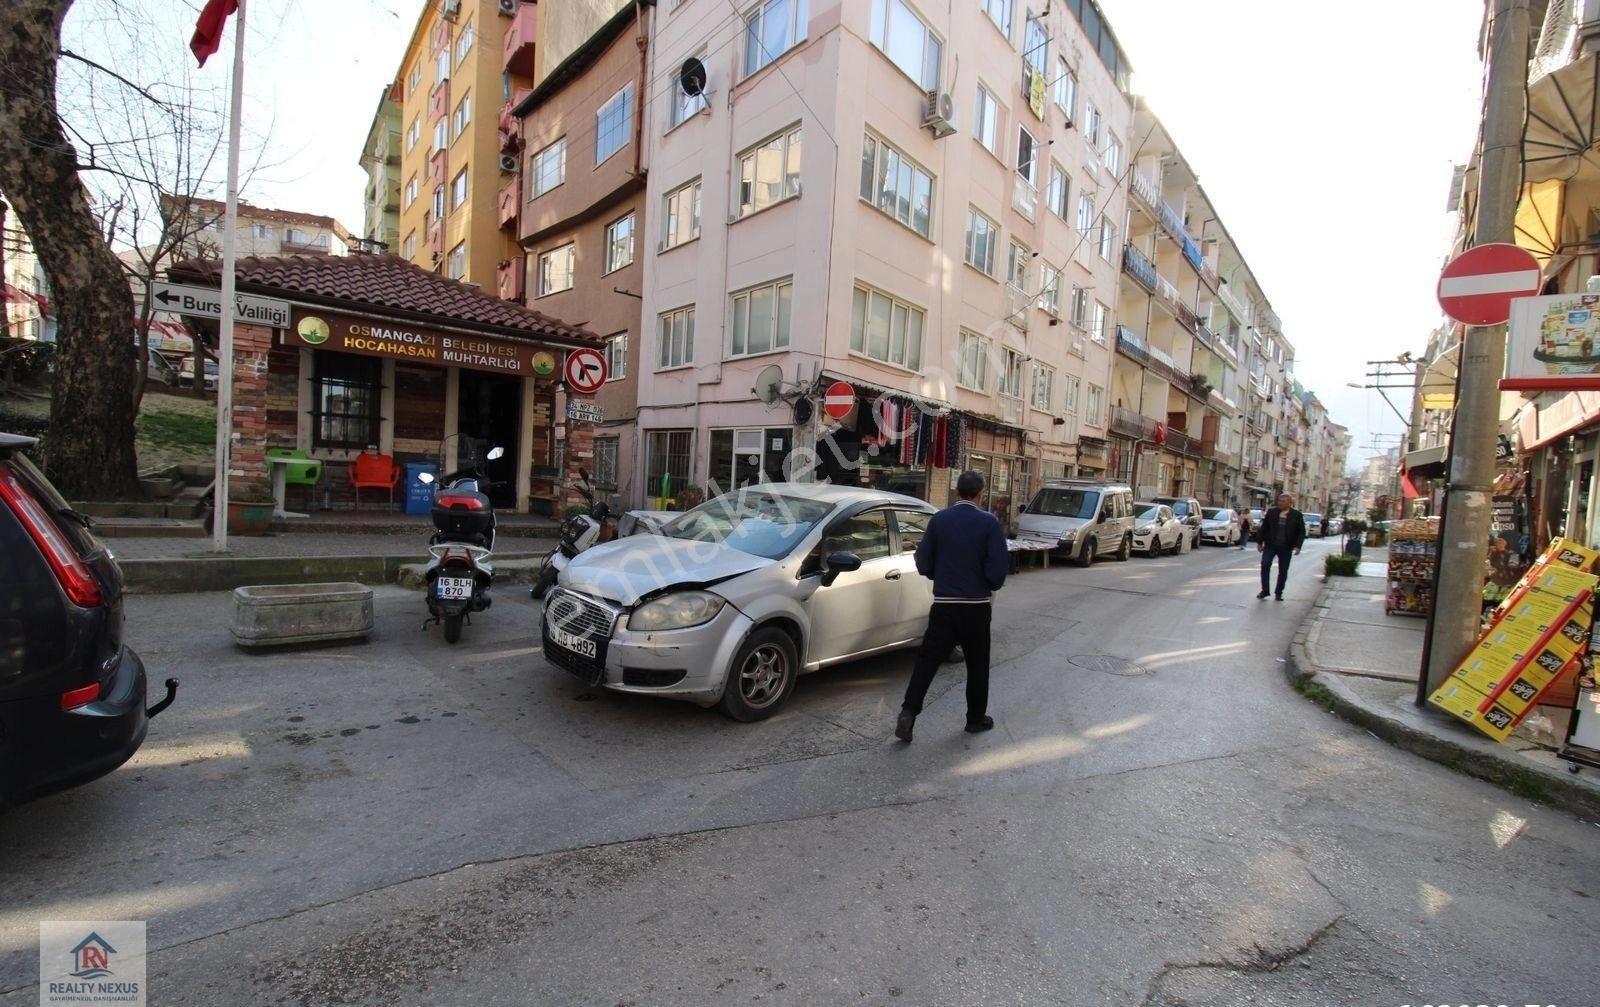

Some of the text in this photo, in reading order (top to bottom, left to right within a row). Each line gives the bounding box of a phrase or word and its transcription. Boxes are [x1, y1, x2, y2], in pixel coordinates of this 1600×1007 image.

[183, 295, 287, 325] Burs Valiliği
[344, 337, 436, 358] HOCAHASAN
[349, 325, 518, 358] OSMANGAZİ BELEDİYESİ
[440, 578, 472, 587] 16 BLH
[444, 587, 464, 596] 870
